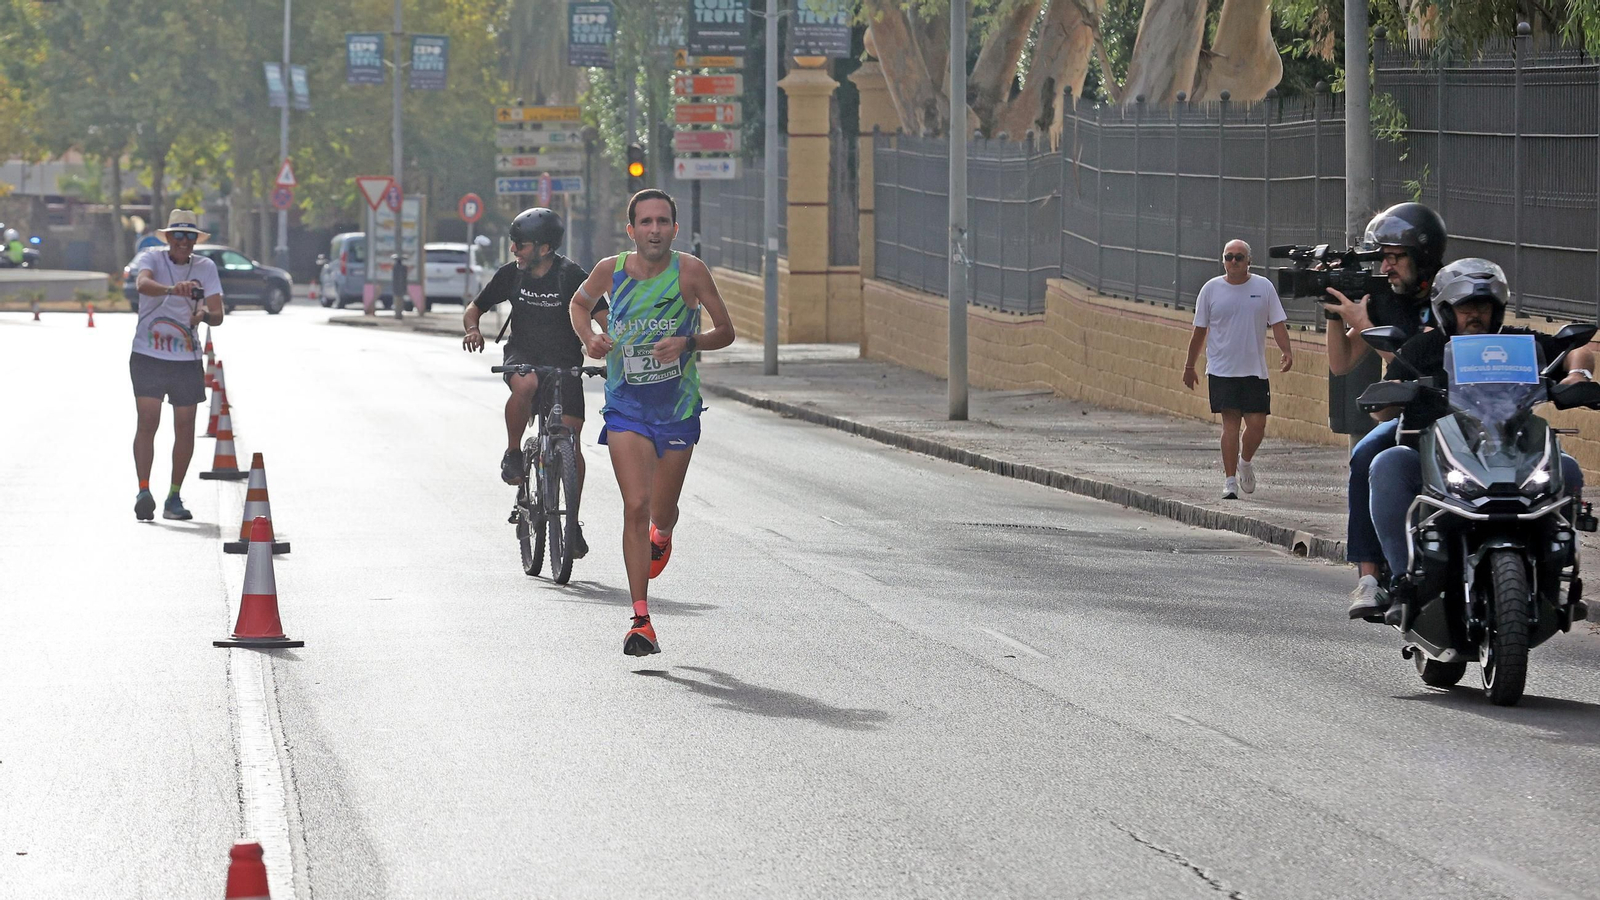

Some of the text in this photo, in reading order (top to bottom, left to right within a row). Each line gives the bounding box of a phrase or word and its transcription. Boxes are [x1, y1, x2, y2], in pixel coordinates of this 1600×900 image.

[572, 14, 608, 24] EXPO
[694, 9, 745, 23] TRUYE
[628, 318, 678, 331] HYGGE
[1459, 364, 1533, 373] VEHÍCULO AUTORIZADO
